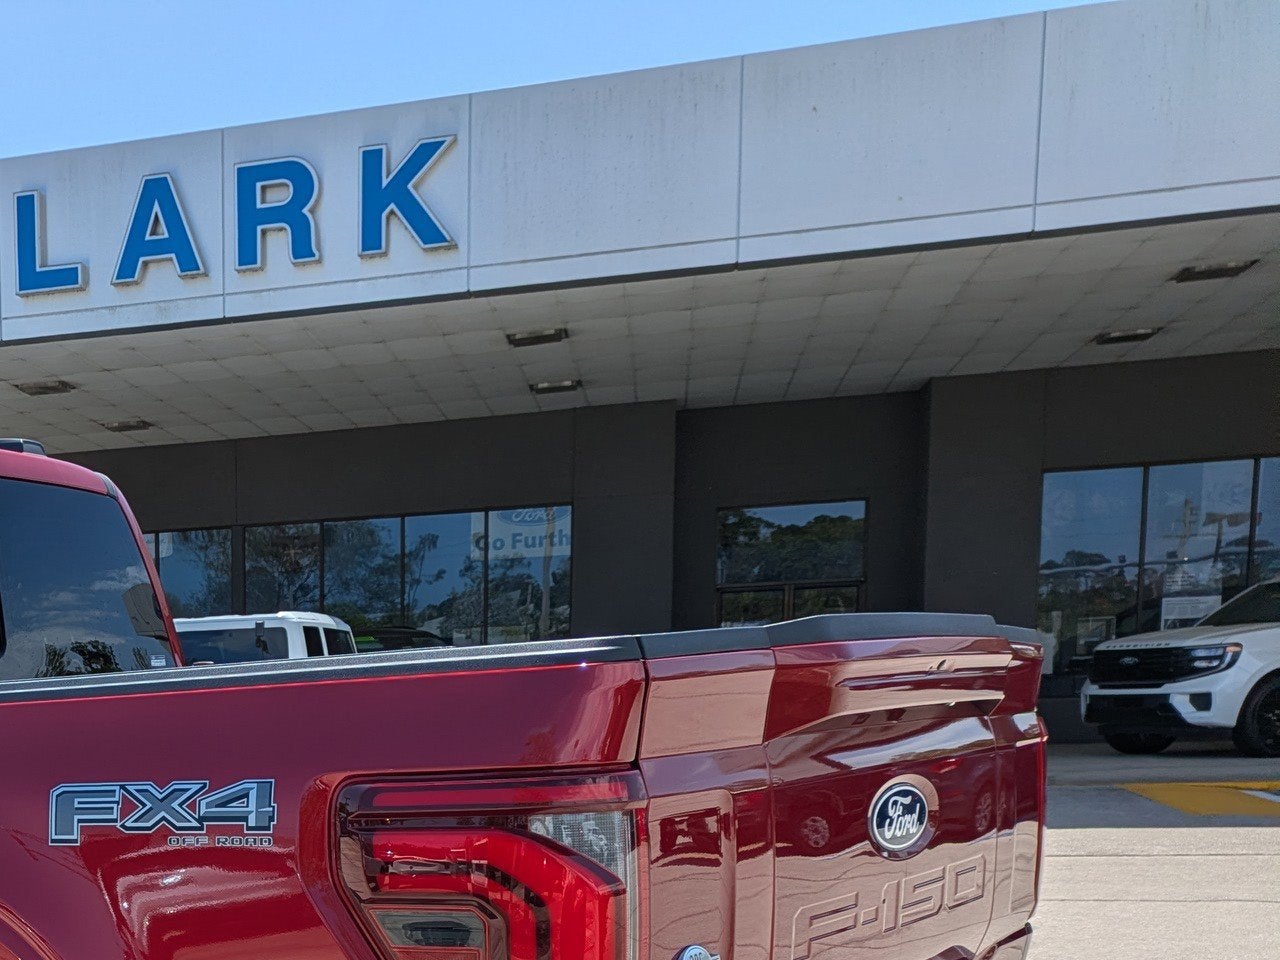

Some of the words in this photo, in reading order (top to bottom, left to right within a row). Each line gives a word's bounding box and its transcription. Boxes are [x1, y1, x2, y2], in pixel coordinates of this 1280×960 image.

[48, 779, 277, 846] FX4
[884, 795, 920, 838] Ford
[167, 835, 209, 847] OFF
[215, 835, 274, 847] ROAD
